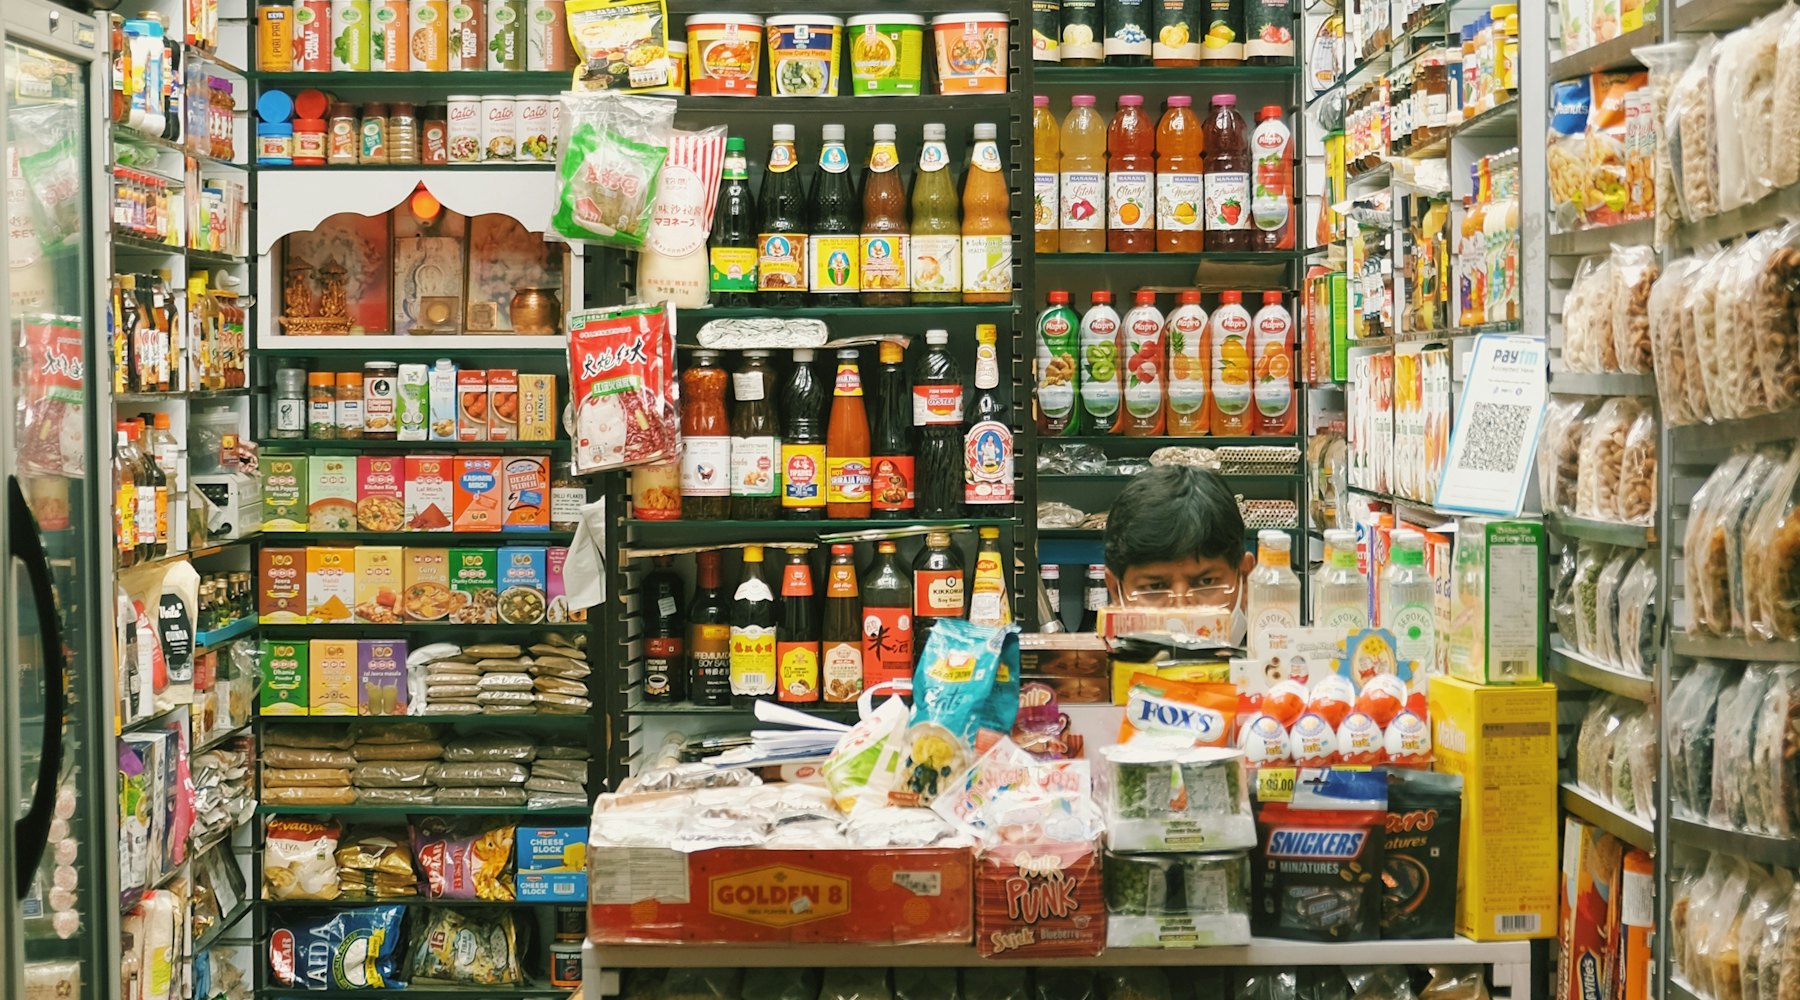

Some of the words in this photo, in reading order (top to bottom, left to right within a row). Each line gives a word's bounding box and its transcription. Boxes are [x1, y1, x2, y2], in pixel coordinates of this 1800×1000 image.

[304, 30, 313, 61] CHILLI
[388, 30, 396, 64] THYME
[462, 28, 471, 58] MIXED
[504, 31, 514, 60] BASIL
[450, 105, 477, 122] Catch
[488, 107, 514, 122] Catch
[522, 104, 548, 120] Catch
[1045, 322, 1068, 332] Mapro
[1092, 322, 1114, 330] Mapro
[1134, 324, 1158, 332] Mapro
[1176, 320, 1200, 328] Mapro
[1224, 320, 1246, 328] Mapro
[1260, 320, 1285, 330] Mapro
[526, 391, 534, 424] MDH
[268, 476, 296, 486] MDH
[510, 474, 536, 484] DEGGI
[510, 481, 537, 491] MIRCH
[1490, 534, 1520, 544] Barley
[1520, 534, 1536, 543] Tea
[268, 568, 296, 578] MDH
[458, 570, 486, 578] MDH
[507, 569, 535, 578] MDH
[694, 652, 723, 660] PREMIUM
[270, 660, 298, 668] MDH
[368, 660, 396, 670] MDH
[1138, 700, 1214, 733] FOX'S
[1386, 809, 1438, 832] ars
[530, 838, 564, 846] CHEESE
[1270, 830, 1364, 856] SNICKERS
[1014, 851, 1064, 879] SOUR
[1280, 862, 1339, 875] MINIATURES
[717, 884, 820, 905] GOLDEN
[828, 884, 843, 905] 8
[1006, 876, 1078, 924] PUNK
[1041, 928, 1079, 940] Blueberry
